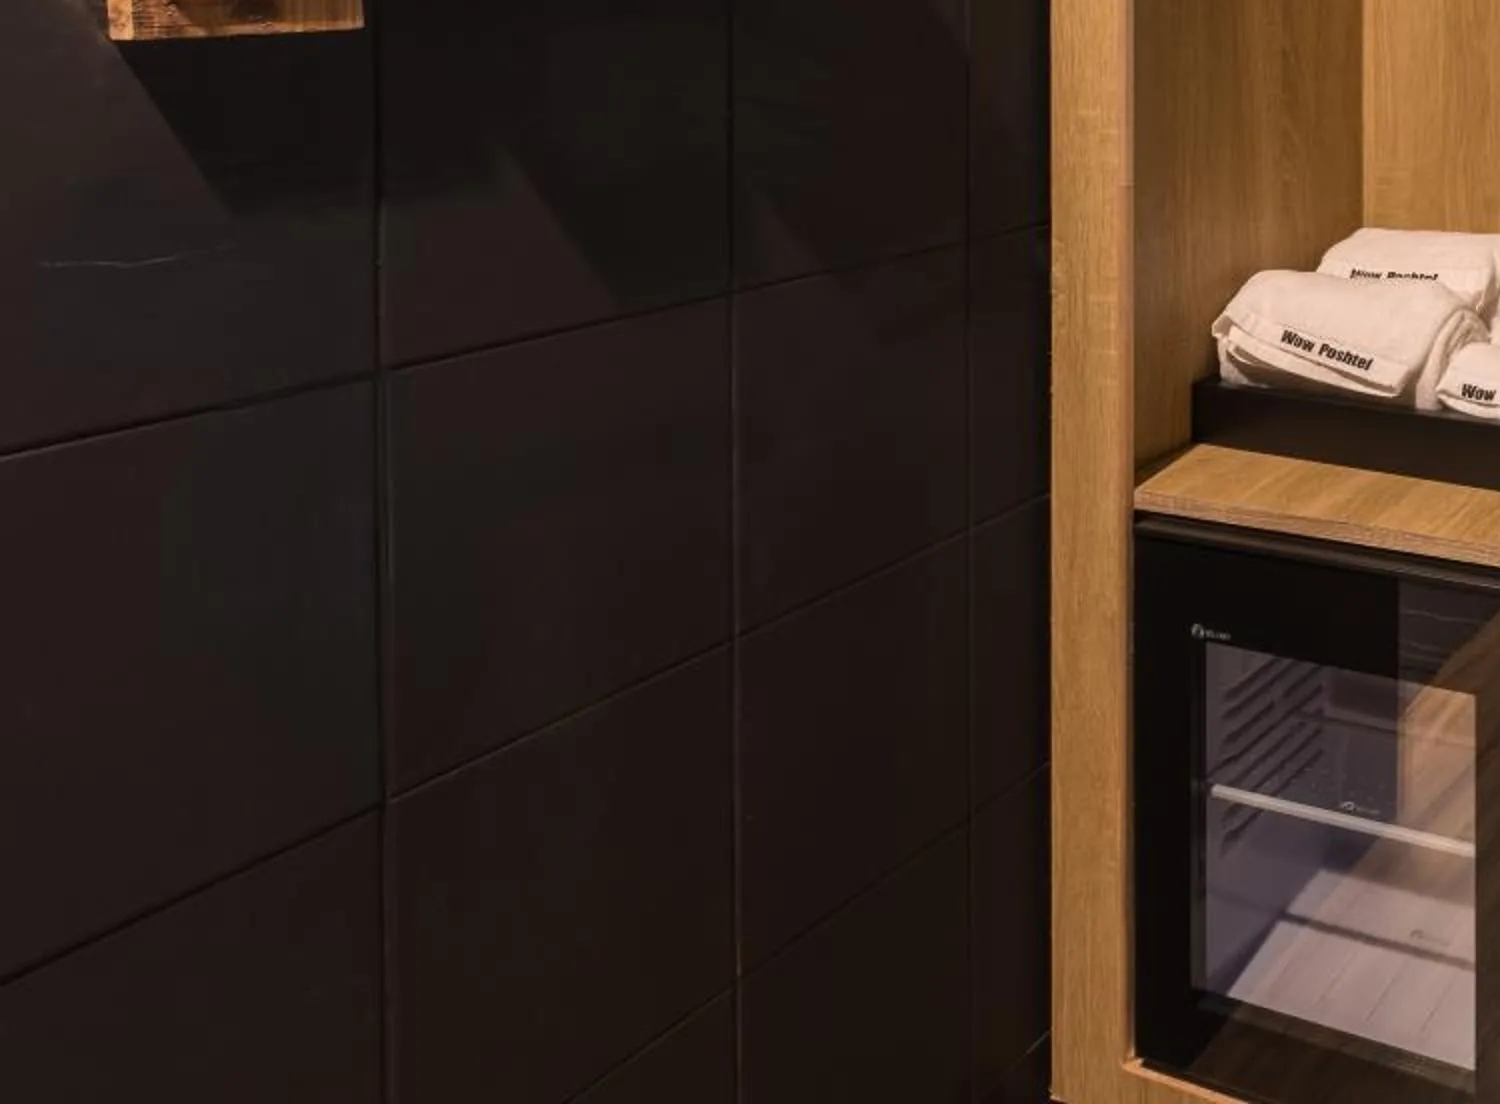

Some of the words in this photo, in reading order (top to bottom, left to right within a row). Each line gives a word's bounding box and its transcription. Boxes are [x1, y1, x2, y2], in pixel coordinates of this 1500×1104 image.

[1281, 329, 1316, 352] Wow
[1318, 343, 1375, 371] Poshtel
[1461, 383, 1496, 401] Wow
